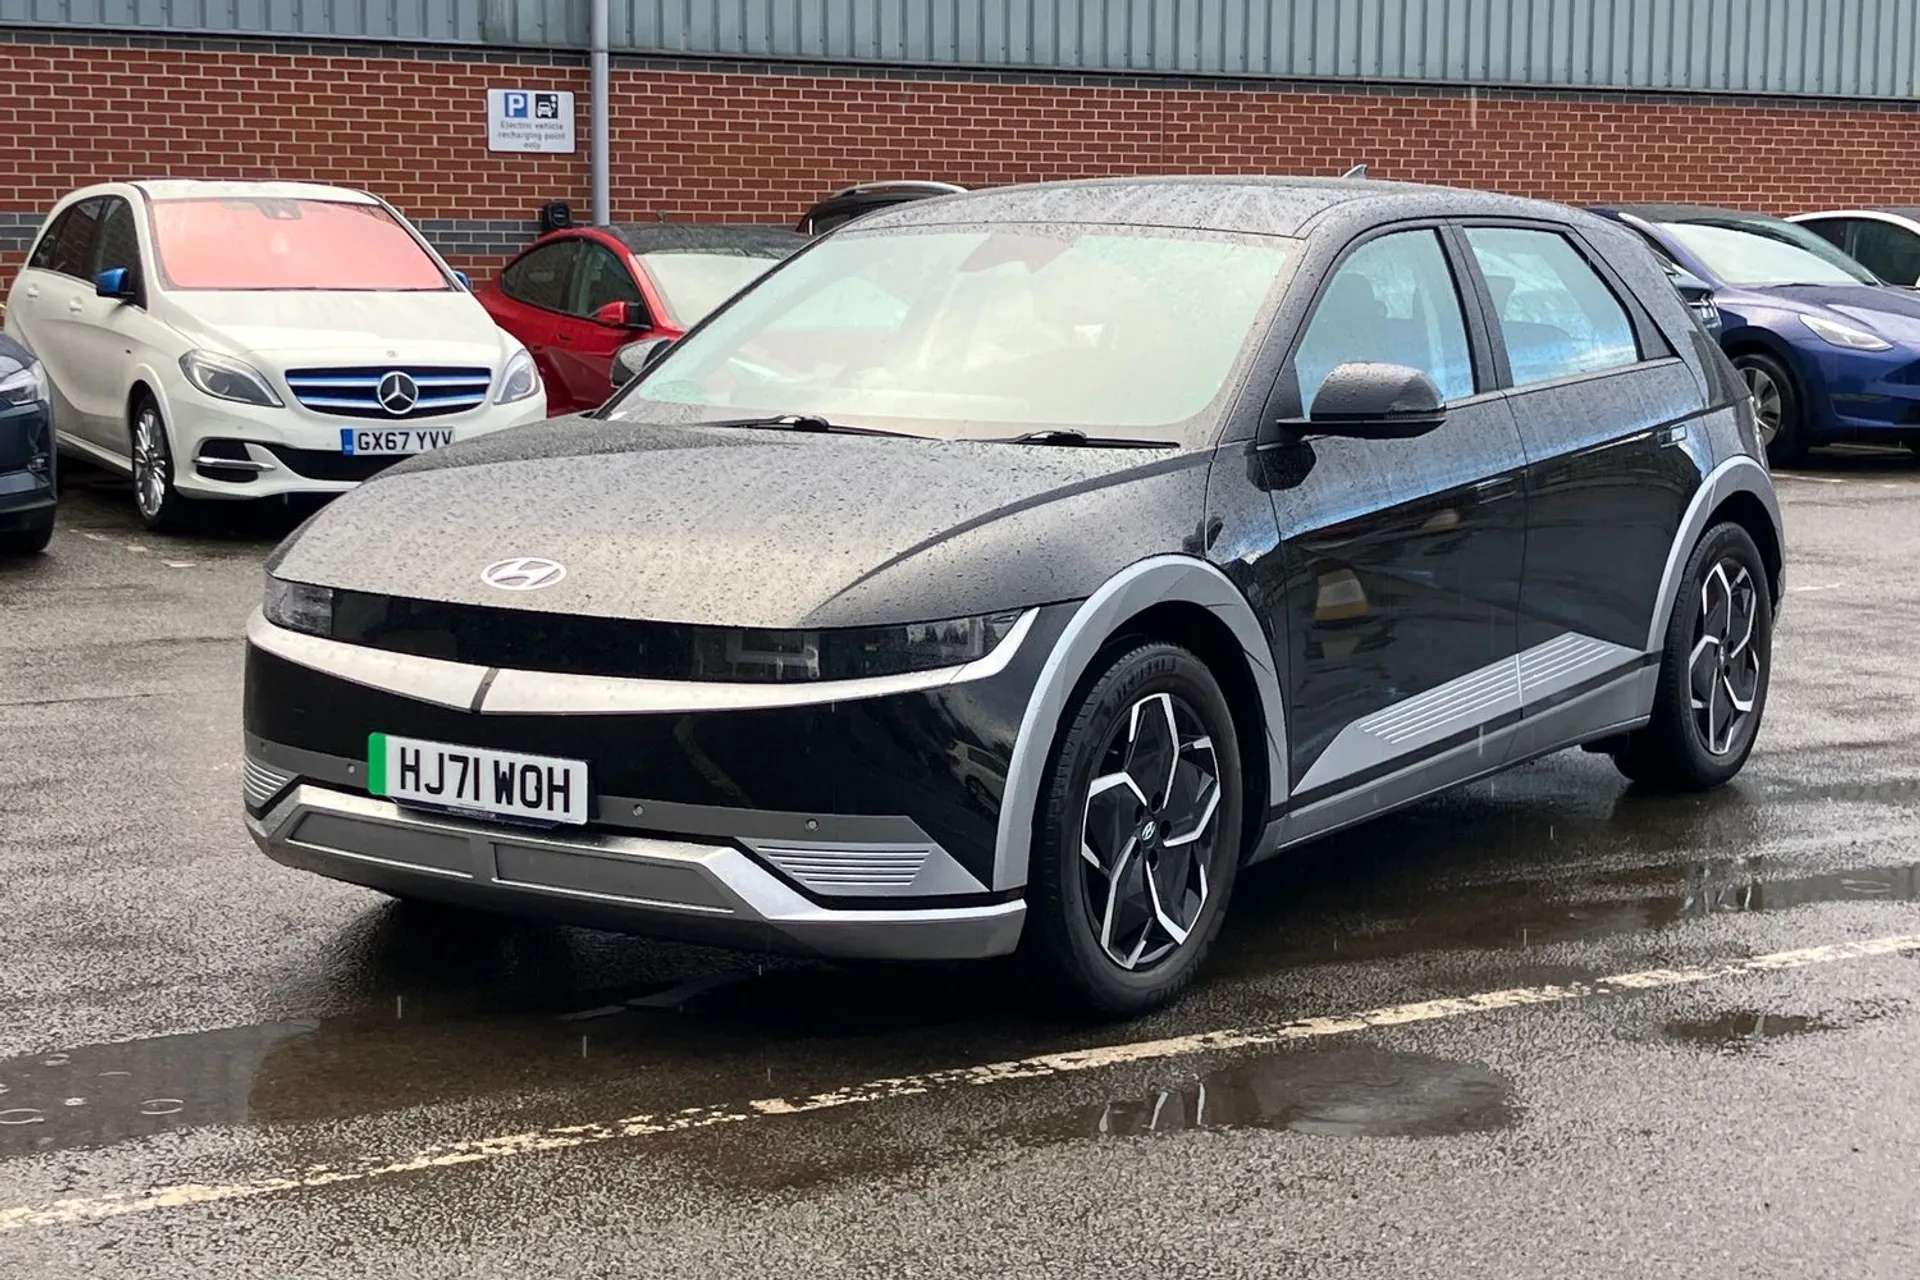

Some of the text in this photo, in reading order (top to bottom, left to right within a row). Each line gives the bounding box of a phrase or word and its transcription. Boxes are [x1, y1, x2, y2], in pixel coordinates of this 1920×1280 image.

[508, 94, 525, 117] P
[500, 121, 563, 130] Electric vehicle
[499, 131, 566, 141] recharging point
[358, 431, 453, 451] GX67 YVV
[400, 747, 571, 813] HJ71 WOH
